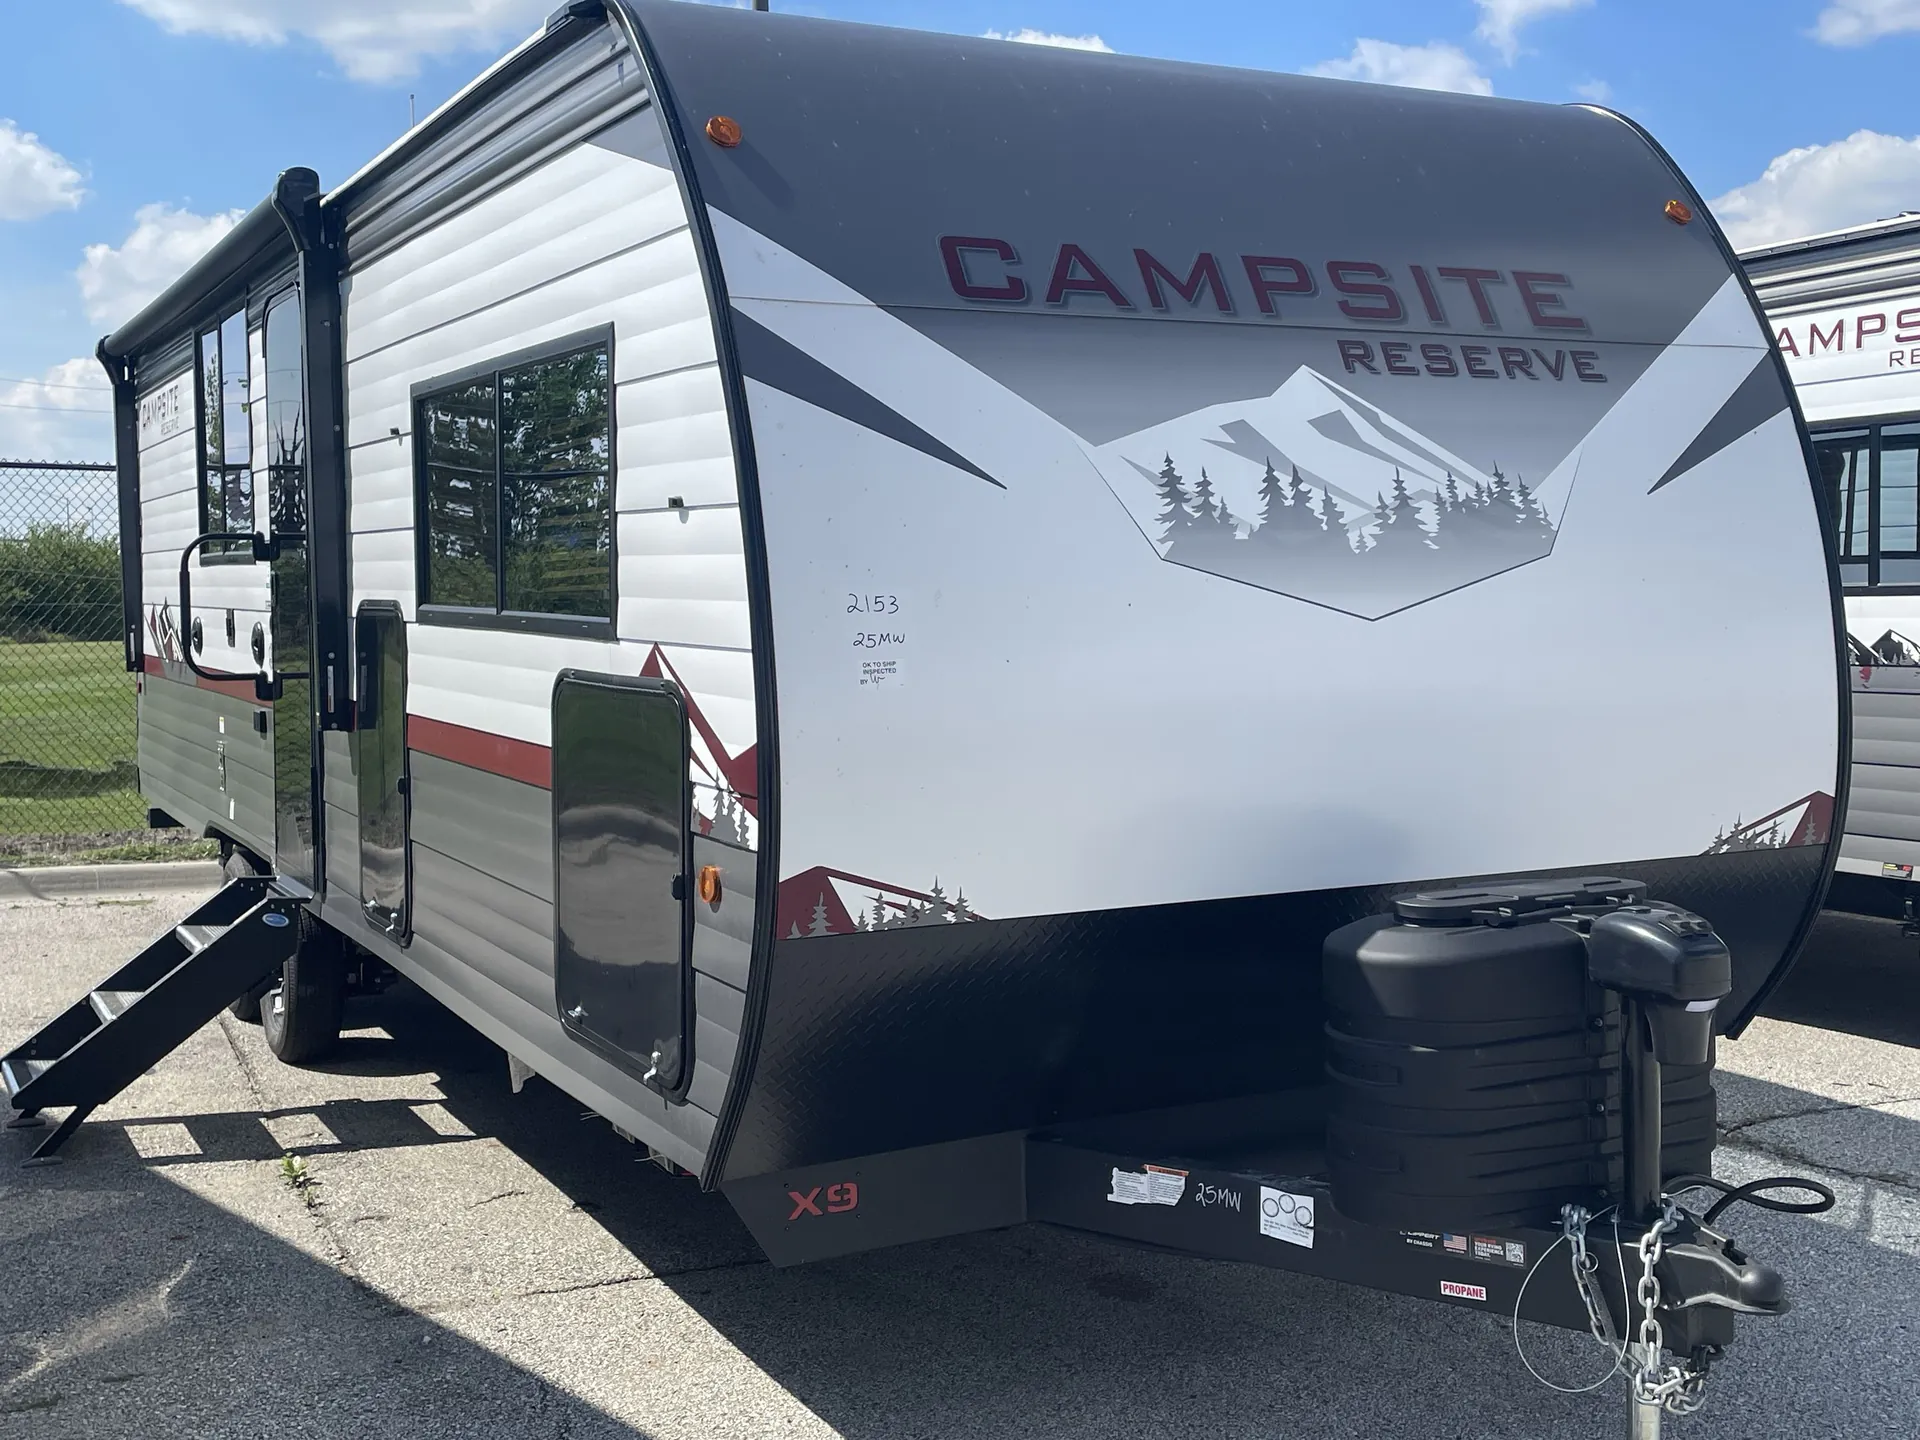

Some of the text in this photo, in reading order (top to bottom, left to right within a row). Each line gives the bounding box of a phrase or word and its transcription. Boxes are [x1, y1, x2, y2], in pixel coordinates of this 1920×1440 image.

[936, 235, 1592, 329] CAMPSITE
[1337, 339, 1608, 382] RESERVE
[847, 593, 899, 614] 2153
[853, 632, 905, 648] 25MW
[788, 1182, 859, 1220] X9
[1442, 1283, 1485, 1299] PROPANE
